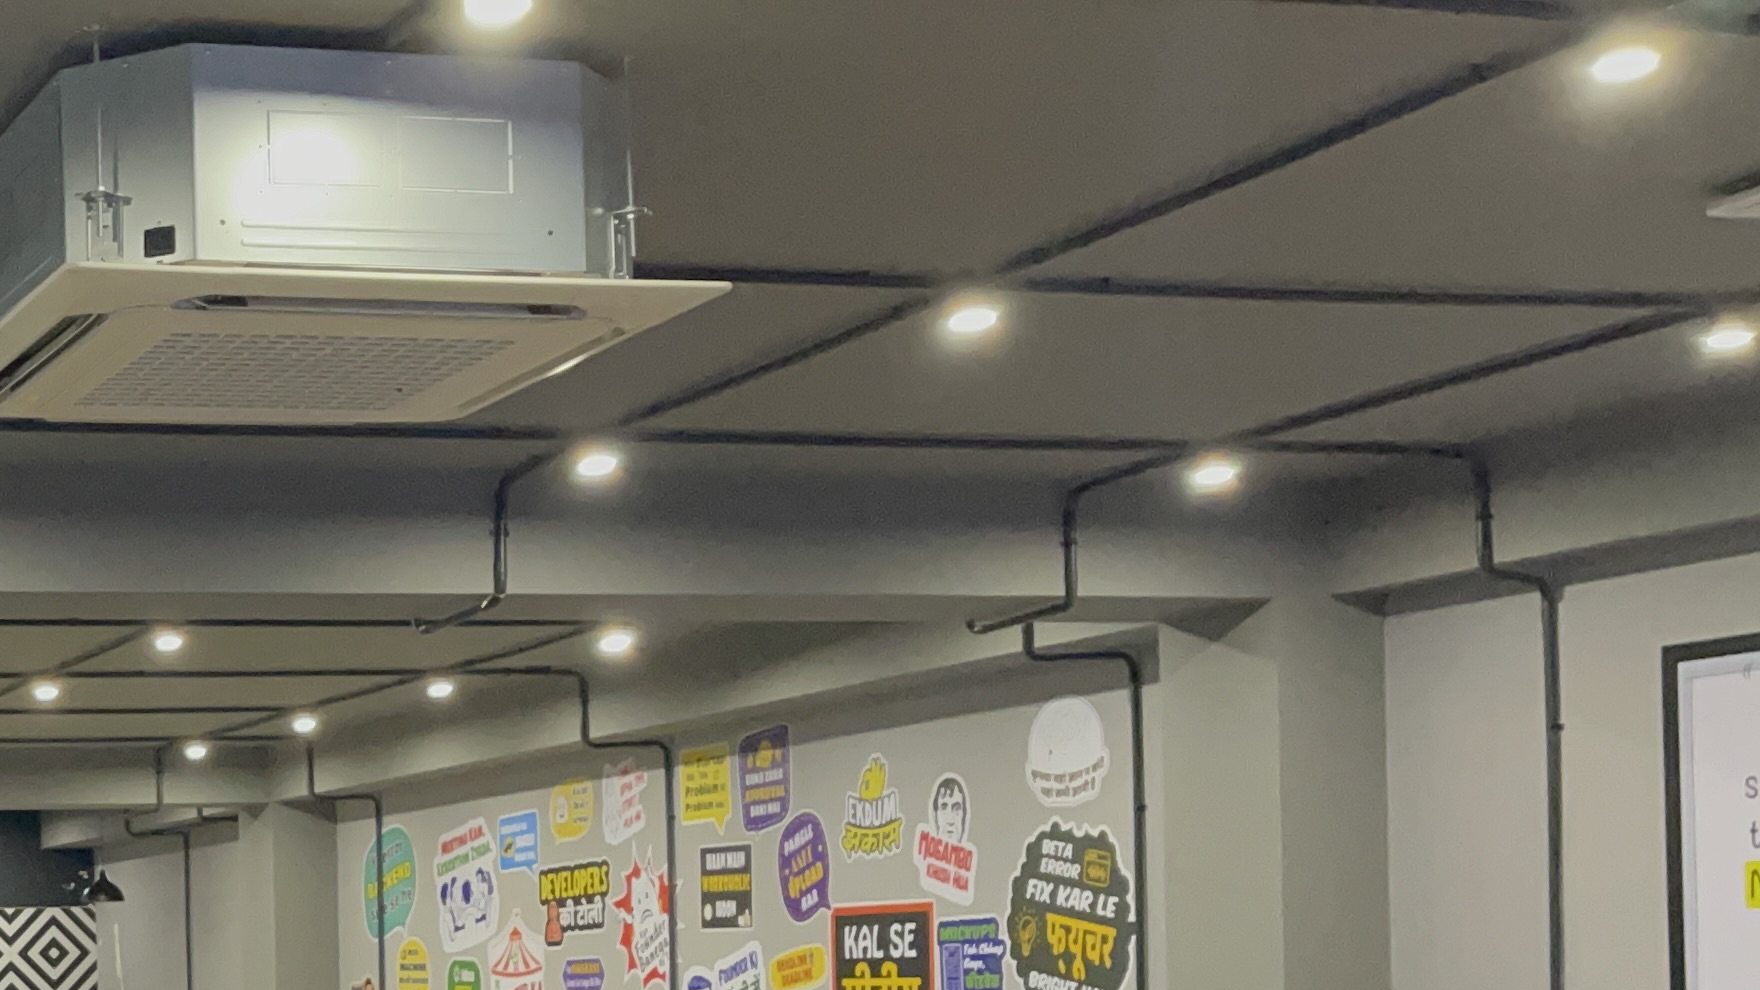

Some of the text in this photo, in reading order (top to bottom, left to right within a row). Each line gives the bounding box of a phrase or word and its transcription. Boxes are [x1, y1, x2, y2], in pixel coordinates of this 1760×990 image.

[848, 792, 897, 826] EKDUM
[842, 818, 903, 859] झकास
[1042, 839, 1073, 859] BETA
[541, 865, 608, 900] DEVELOPERS
[788, 861, 824, 899] UPLOAD
[1040, 858, 1081, 880] ERROR
[559, 895, 603, 927] की टोली
[801, 888, 819, 912] KAR
[1026, 878, 1119, 918] FIX KAR LE
[844, 924, 884, 959] KAL
[890, 922, 917, 958] SE
